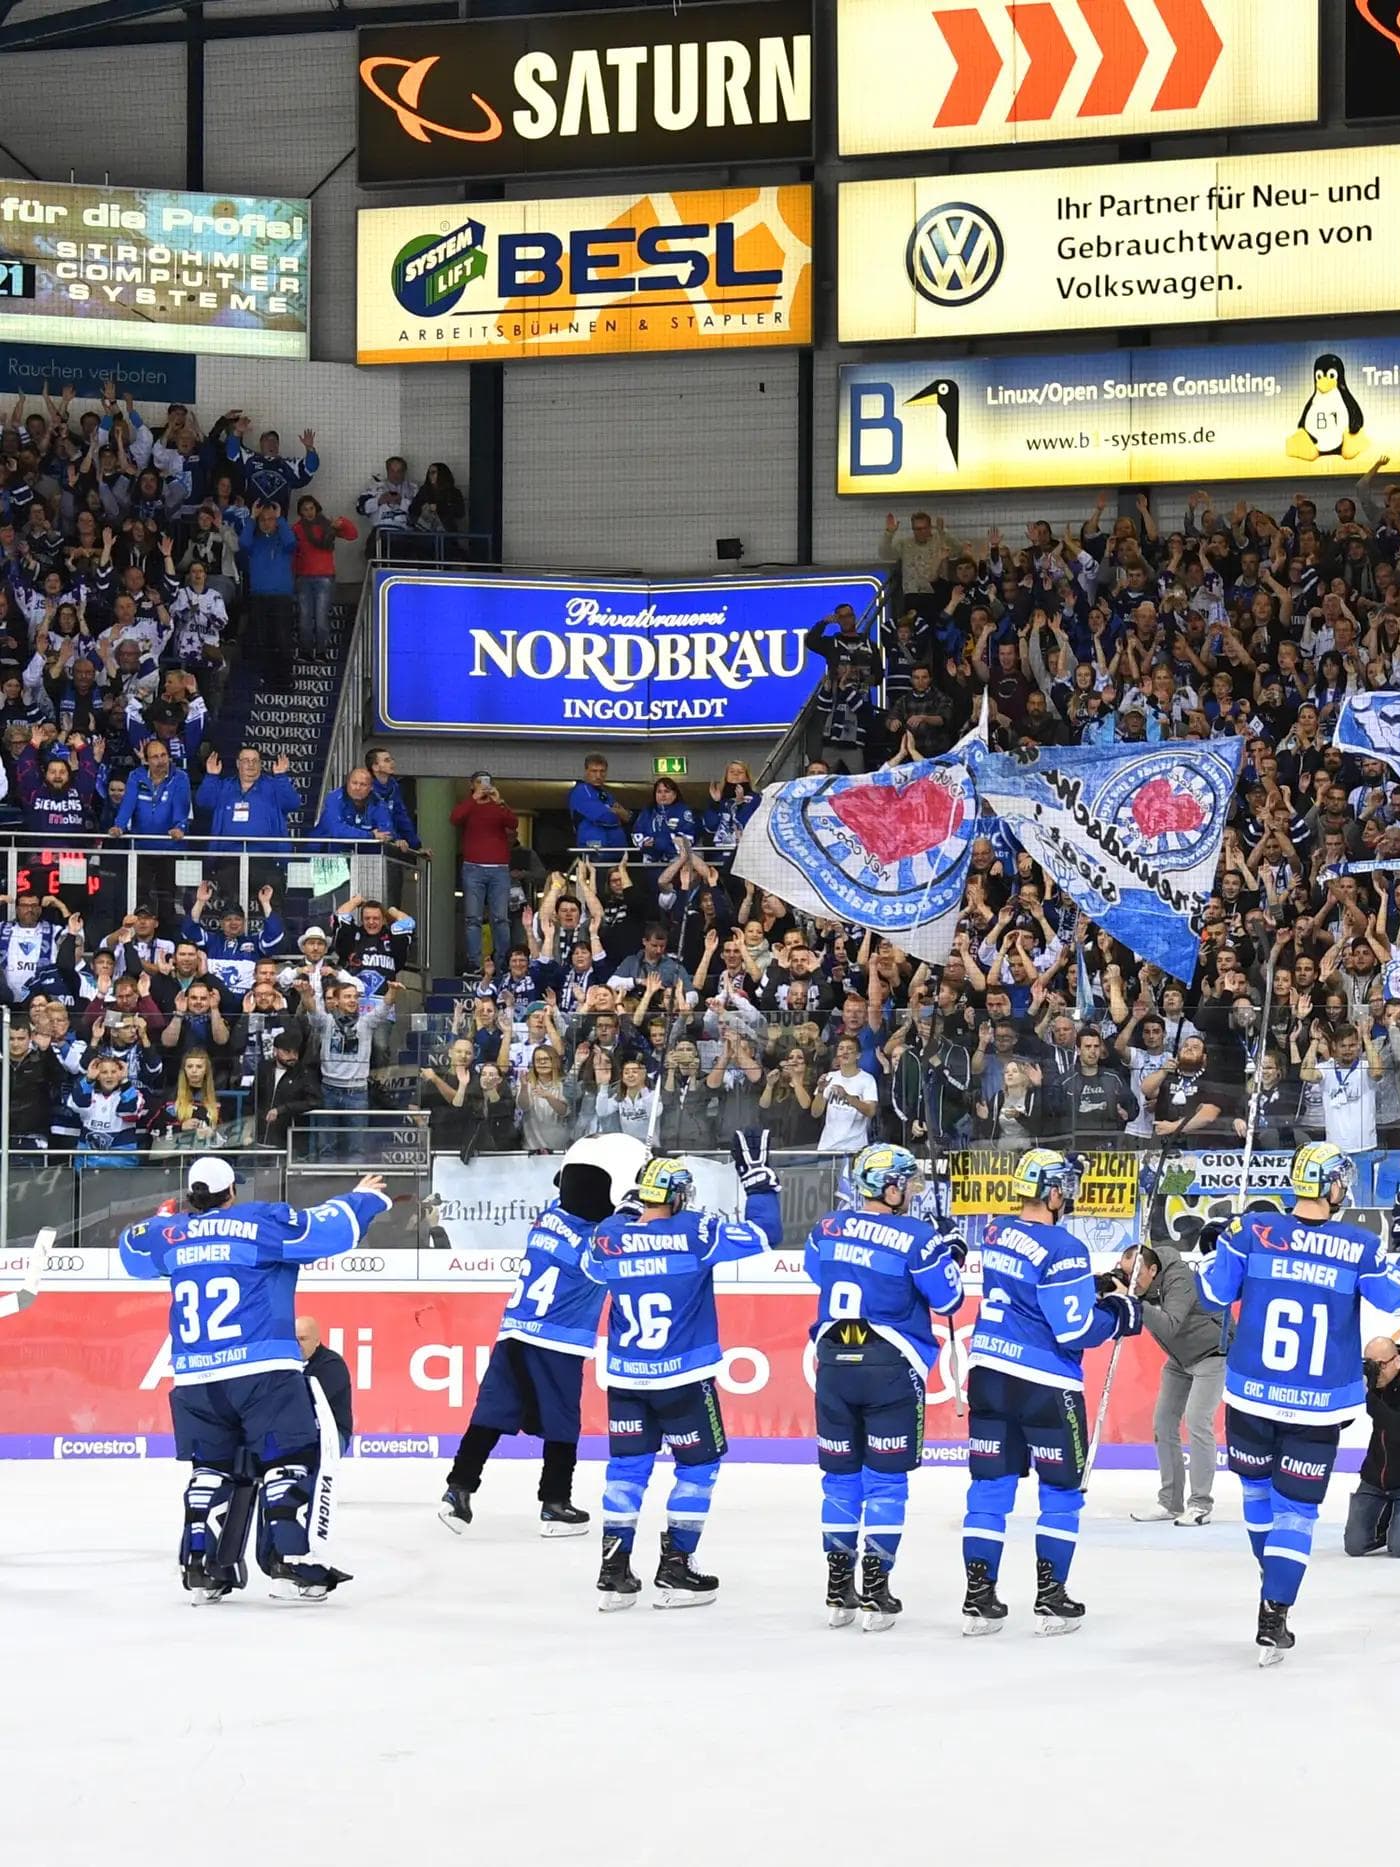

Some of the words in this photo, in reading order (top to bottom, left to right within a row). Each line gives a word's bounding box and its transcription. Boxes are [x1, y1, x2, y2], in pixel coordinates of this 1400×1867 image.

[513, 34, 811, 140] SATURN
[1056, 197, 1092, 221] Ihr
[1099, 193, 1199, 218] Partner
[1207, 187, 1245, 211] für
[1253, 184, 1319, 209] Neu-
[1327, 176, 1380, 203] und
[1, 197, 68, 225] für
[82, 203, 146, 230] die
[162, 207, 303, 241] Profis!
[56, 241, 299, 273] STRÖHMER
[404, 227, 474, 283] SYSTEM
[1056, 229, 1308, 260] Gebrauchtwagen
[1318, 224, 1373, 244] von
[436, 256, 475, 295] LIFT
[498, 222, 783, 299] BESL
[56, 262, 299, 294] COMPUTER
[1056, 272, 1243, 300] Volkswagen.
[68, 284, 287, 313] SYSTEME
[399, 319, 617, 342] ARBEITSBÜHNEN
[638, 319, 649, 331] &
[671, 311, 783, 330] STAPLER
[8, 358, 83, 380] Rauchen
[88, 364, 168, 385] verboten
[987, 382, 1097, 407] Linux/Open
[1103, 379, 1168, 400] Source
[1172, 373, 1281, 398] Consulting,
[565, 597, 727, 630] Privatbrauerei
[468, 628, 808, 693] NORDBRÄU
[563, 698, 728, 721] INGOLSTADT
[33, 798, 82, 812] SIEMENS
[952, 1176, 982, 1203] FÜR
[186, 1218, 259, 1240] SATURN
[621, 1233, 689, 1254] SATURN
[842, 1217, 914, 1254] SATURN
[176, 1244, 231, 1265] REIMER
[833, 1242, 874, 1267] BUCK
[1290, 1229, 1365, 1264] SATURN
[0, 1256, 30, 1271] udi
[449, 1257, 494, 1271] Audi
[618, 1257, 668, 1278] OLSON
[1271, 1258, 1338, 1288] ELSNER
[174, 1276, 242, 1344] 32
[618, 1292, 673, 1351] 16
[1063, 1294, 1083, 1324] 2
[1261, 1298, 1329, 1377] 61
[1243, 1380, 1264, 1398] ERC
[1268, 1386, 1332, 1408] INGOLSTADT
[60, 1437, 137, 1456] covestro
[360, 1436, 428, 1454] covestro
[1280, 1455, 1328, 1477] CINQUE
[316, 1475, 333, 1541] VAUGHN
